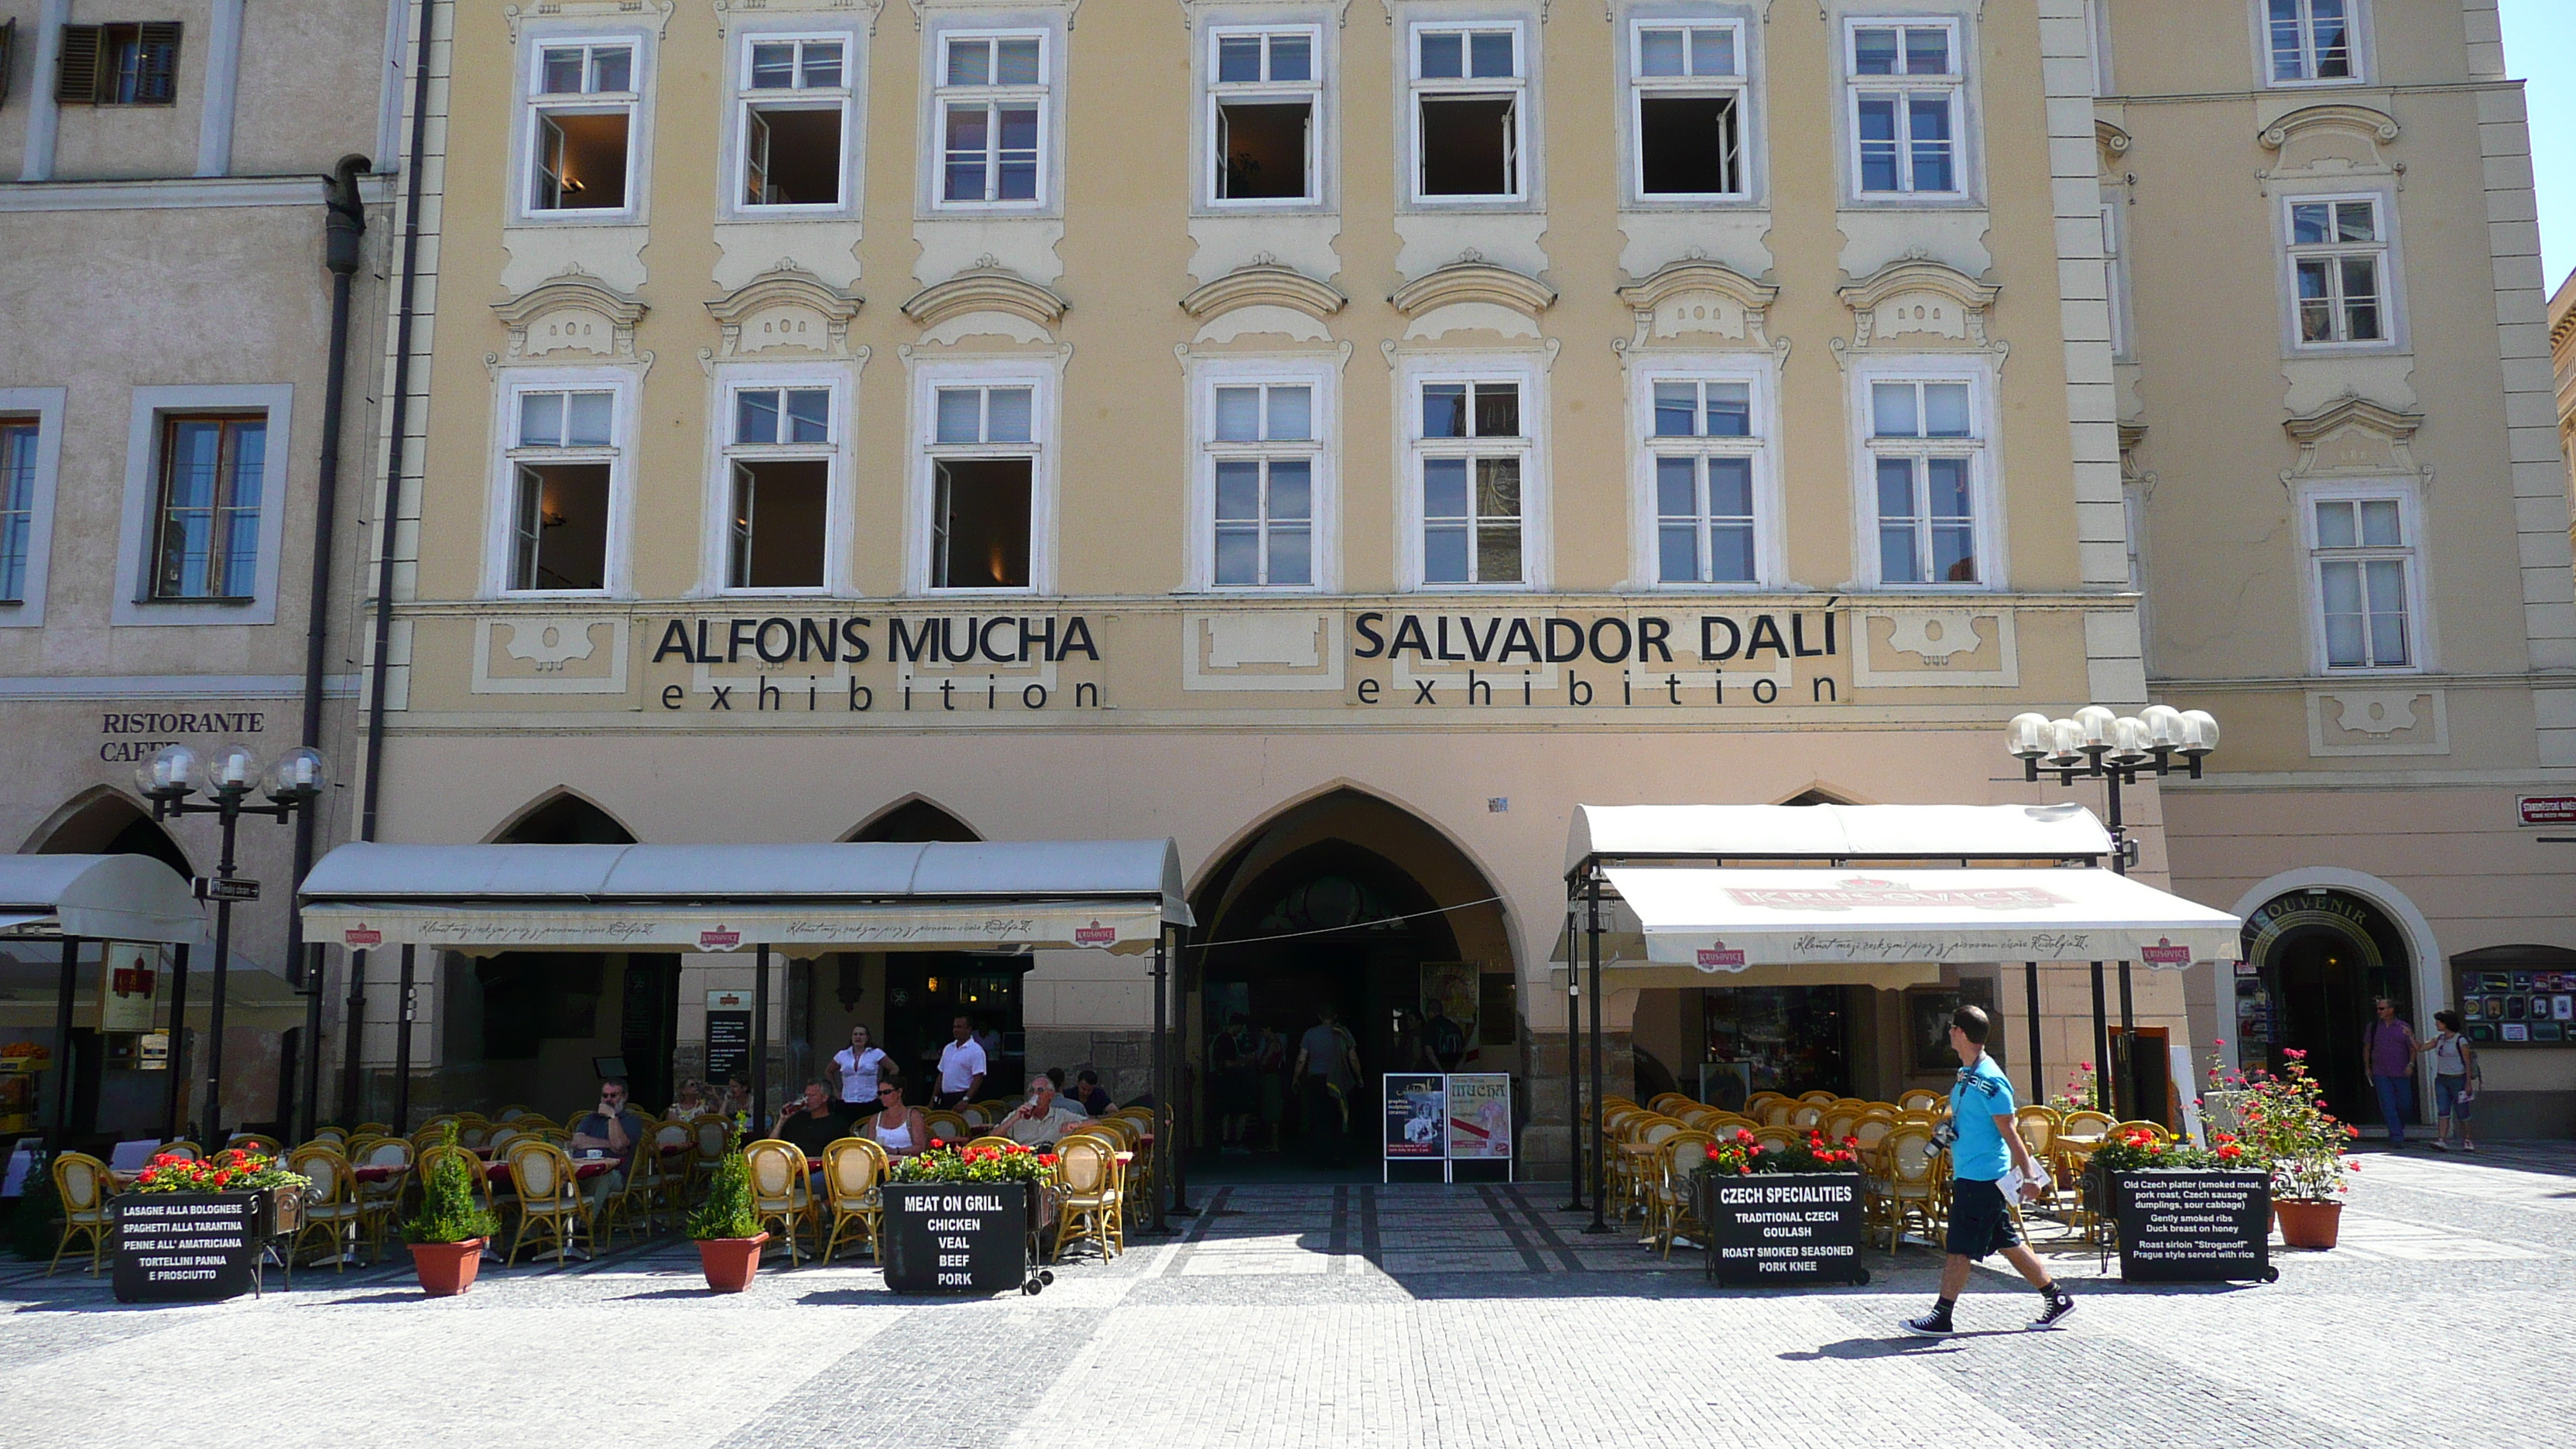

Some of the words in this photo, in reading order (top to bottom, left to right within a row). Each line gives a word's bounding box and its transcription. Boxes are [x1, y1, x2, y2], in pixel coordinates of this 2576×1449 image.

[1354, 611, 1673, 664] SALVADOR
[1701, 596, 1841, 661] DALÍ
[652, 617, 872, 663] ALFONS
[888, 616, 1100, 663] MUCHA
[662, 674, 1098, 711] exhibition
[1357, 670, 1837, 706] exhibition
[101, 713, 265, 733] RISTORANTE
[2256, 896, 2366, 924] SOUVENIR
[1451, 1084, 1506, 1099] MUCHA
[2169, 1181, 2196, 1190] platter
[2199, 1180, 2235, 1189] (smoked
[1721, 1188, 1762, 1204] CZECH
[1766, 1186, 1852, 1203] SPECIALITIES
[2136, 1191, 2154, 1200] pork
[905, 1196, 939, 1211] MEAT
[943, 1196, 961, 1211] ON
[965, 1195, 1002, 1211] GRILL
[2136, 1201, 2182, 1210] dumplings,
[2206, 1201, 2245, 1210] cabbage)
[124, 1206, 164, 1216] LASAGNE
[166, 1205, 188, 1214] ALLA
[190, 1204, 242, 1214] BOLOGNESE
[1735, 1212, 1802, 1223] TRADITIONAL
[1805, 1211, 1838, 1221] CZECH
[2151, 1214, 2178, 1223] Gently
[123, 1223, 170, 1233] SPAGHETTI
[171, 1222, 193, 1231] ALLA
[195, 1221, 242, 1231] TARANTINA
[928, 1218, 980, 1231] CHICKEN
[2212, 1225, 2239, 1234] honey
[1763, 1227, 1811, 1237] GOULASH
[124, 1241, 155, 1250] PENNE
[157, 1239, 177, 1249] ALL'
[179, 1238, 242, 1249] AMATRICIANA
[938, 1237, 969, 1249] VEAL
[2194, 1241, 2248, 1249] "Stroganoff"
[1722, 1248, 1755, 1258] ROAST
[1757, 1247, 1798, 1257] SMOKED
[1801, 1246, 1853, 1256] SEASONED
[139, 1257, 193, 1266] TORTELLINI
[195, 1255, 227, 1266] PANNA
[940, 1255, 969, 1266] BEEF
[1759, 1262, 1786, 1272] PORK
[1790, 1262, 1817, 1271] KNEE
[149, 1272, 156, 1280] E
[158, 1270, 216, 1280] PROSCIUTTO
[938, 1273, 972, 1285] PORK
